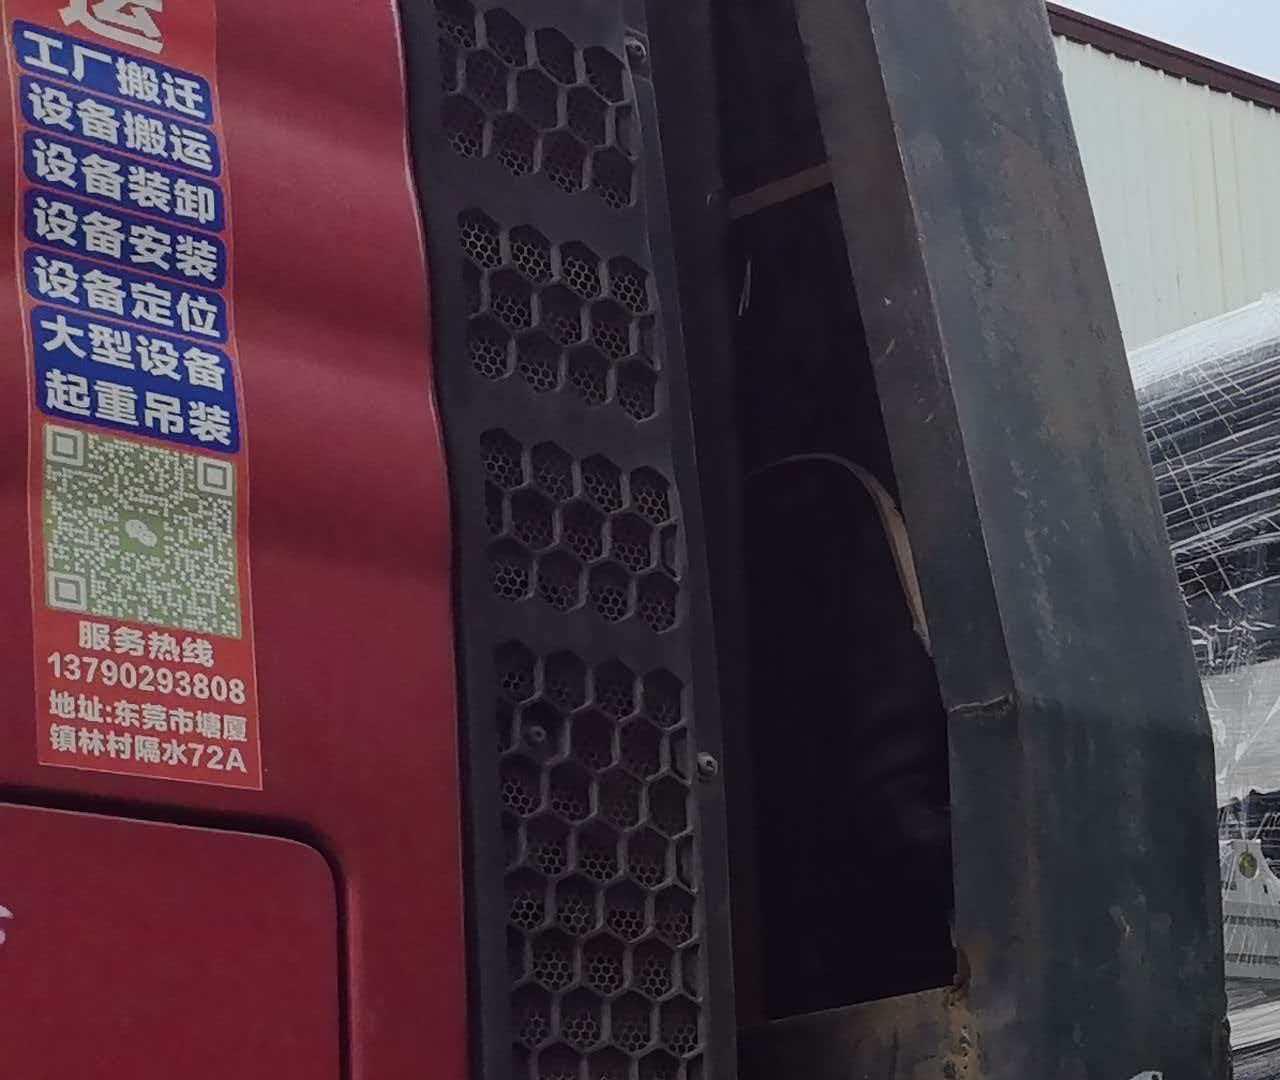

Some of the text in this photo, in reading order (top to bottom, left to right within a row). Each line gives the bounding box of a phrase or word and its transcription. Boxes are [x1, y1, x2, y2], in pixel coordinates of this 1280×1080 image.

[22, 30, 206, 119] 工厂搬迁
[28, 82, 213, 171] 设备搬运
[32, 139, 216, 225] 设备装卸
[32, 196, 218, 282] 设备安装
[33, 256, 221, 339] 设备定位
[40, 315, 226, 392] 大型设备
[45, 368, 231, 446] 起重吊装
[47, 652, 246, 705] 13790293808
[78, 620, 215, 668] 服务热线
